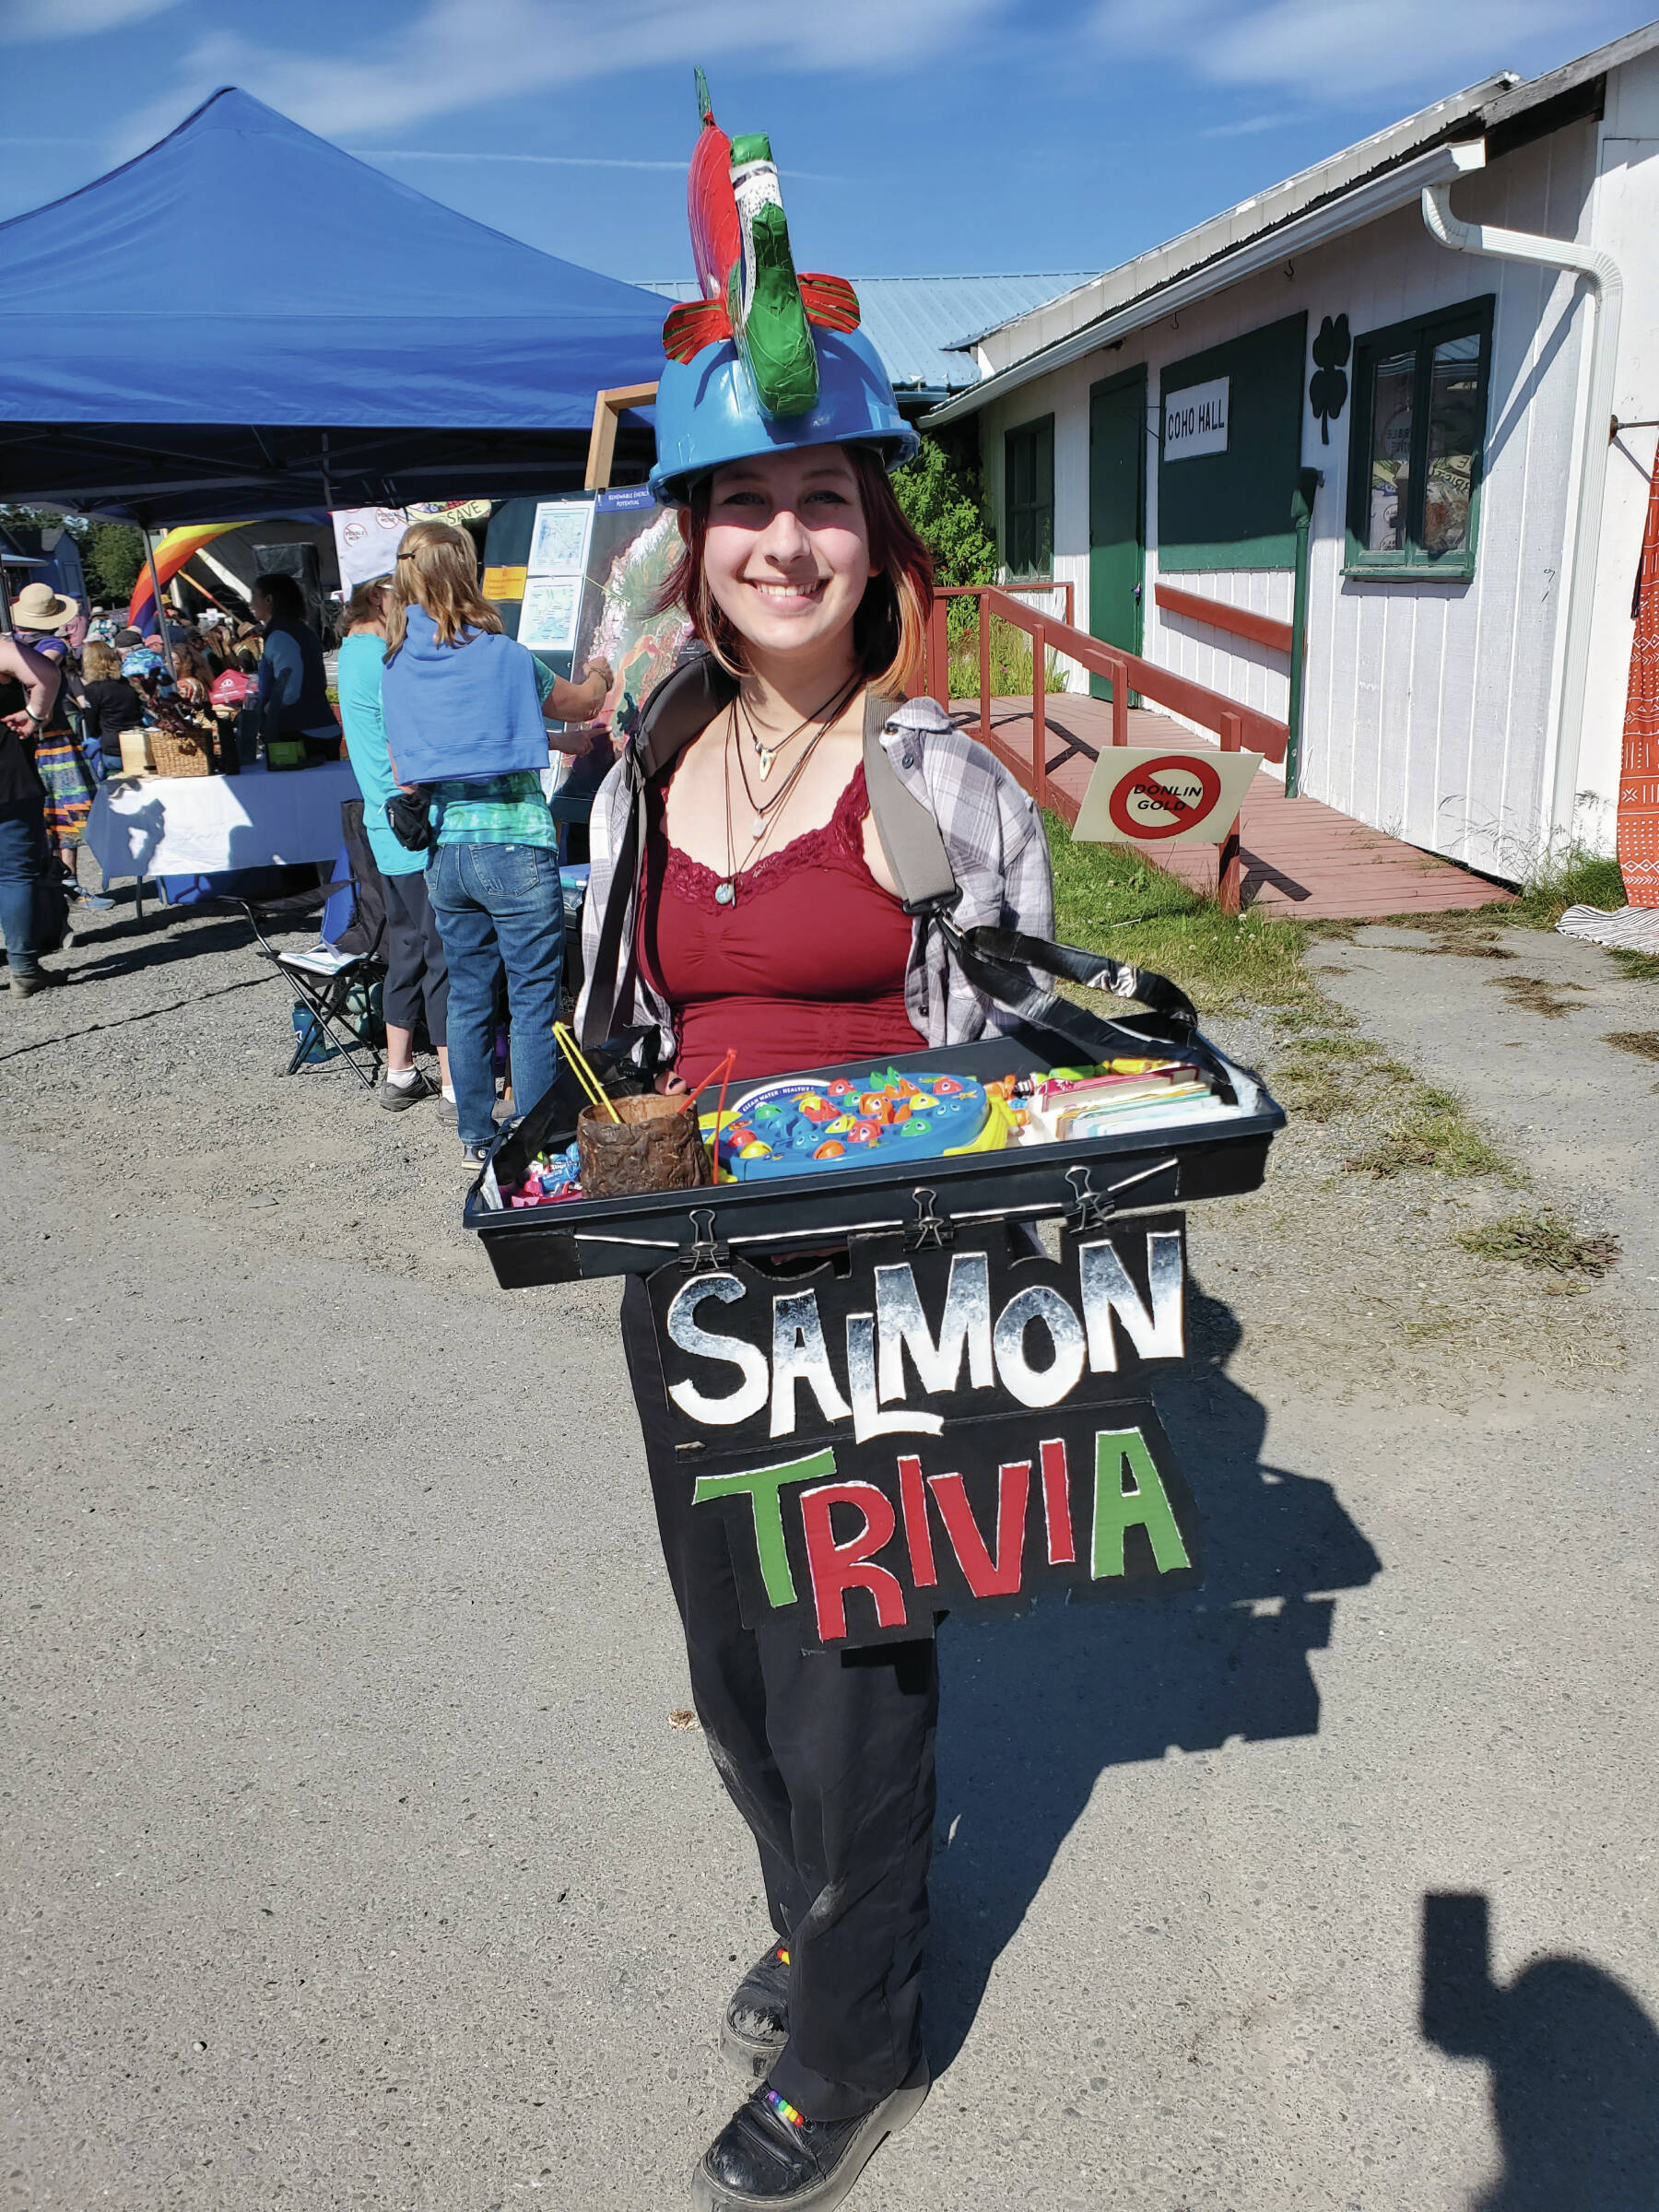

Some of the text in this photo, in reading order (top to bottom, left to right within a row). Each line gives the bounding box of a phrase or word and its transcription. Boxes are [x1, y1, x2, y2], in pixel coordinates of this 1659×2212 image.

[1168, 399, 1224, 441] COHO HALL
[446, 501, 482, 524] SAVE
[617, 499, 640, 507] POTENTIAL
[1133, 783, 1202, 797] DONLIN
[1137, 799, 1186, 811] GOLD
[742, 1086, 810, 1112] CLEAN WATER HEALTHY
[667, 1231, 1185, 1445] SALMON
[692, 1426, 1192, 1642] TRIVIA
